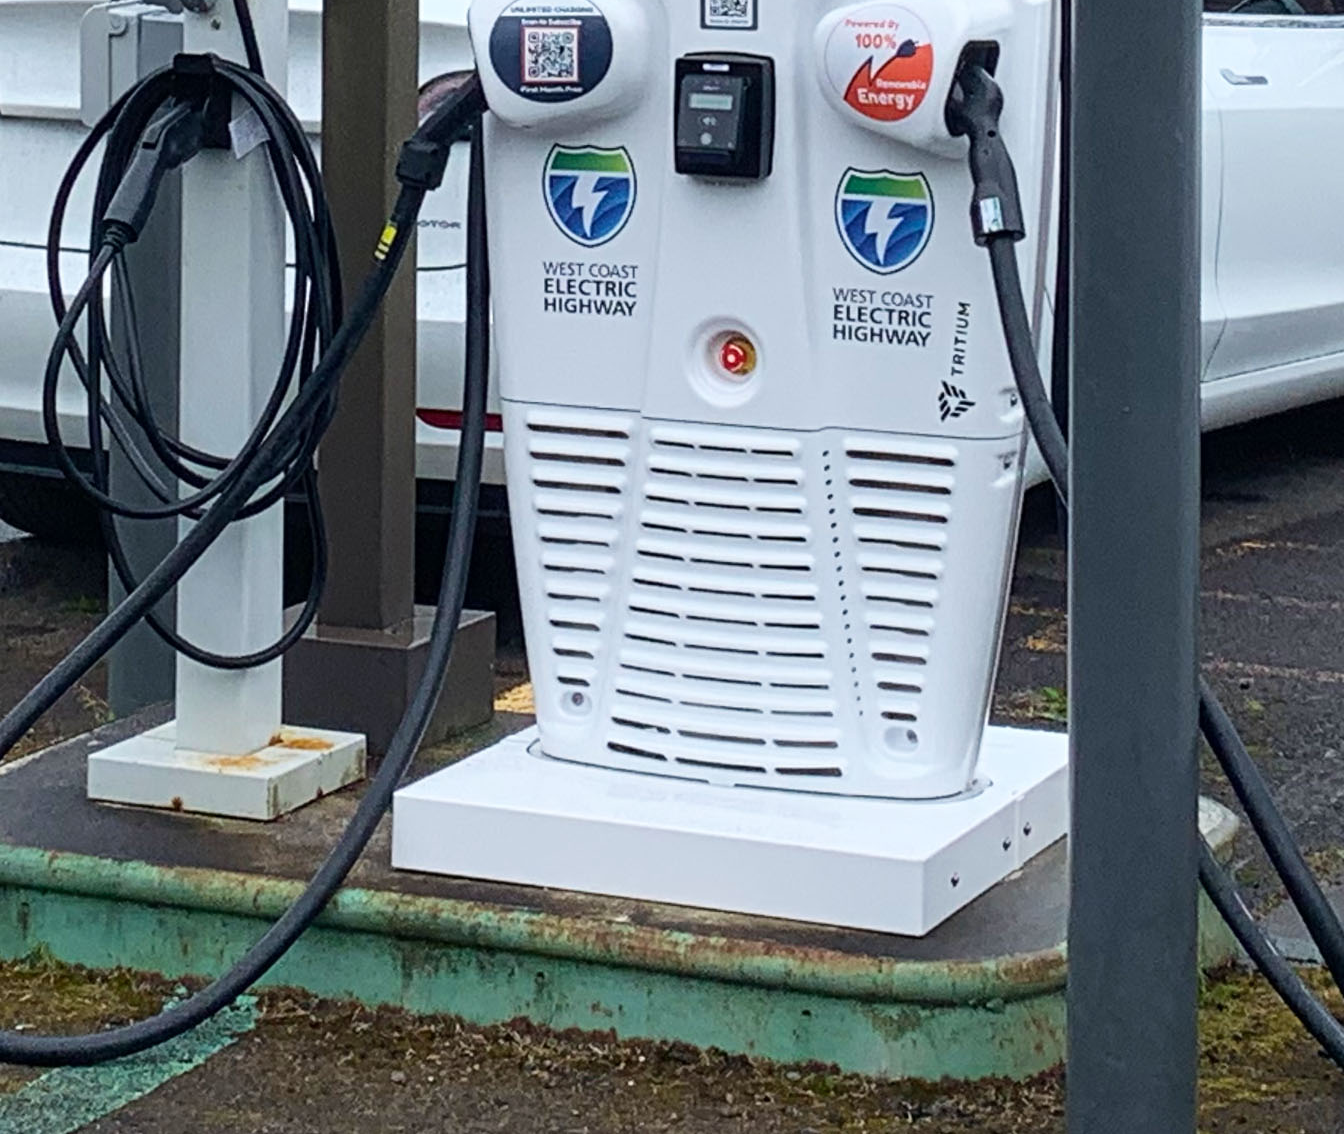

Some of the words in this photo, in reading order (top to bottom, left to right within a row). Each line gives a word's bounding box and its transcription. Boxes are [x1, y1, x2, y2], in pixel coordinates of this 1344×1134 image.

[856, 34, 896, 49] 100%
[857, 88, 914, 110] Energy
[417, 220, 461, 228] OTOR
[543, 262, 584, 276] WEST
[588, 264, 638, 278] COAST
[543, 278, 637, 298] ELECTRIC
[833, 287, 876, 304] WEST
[881, 291, 934, 309] COAST
[543, 297, 637, 317] HIGHWAY
[833, 304, 932, 328] ELECTRIC
[833, 324, 931, 348] HIGHWAY
[951, 301, 971, 376] TRITIUM
